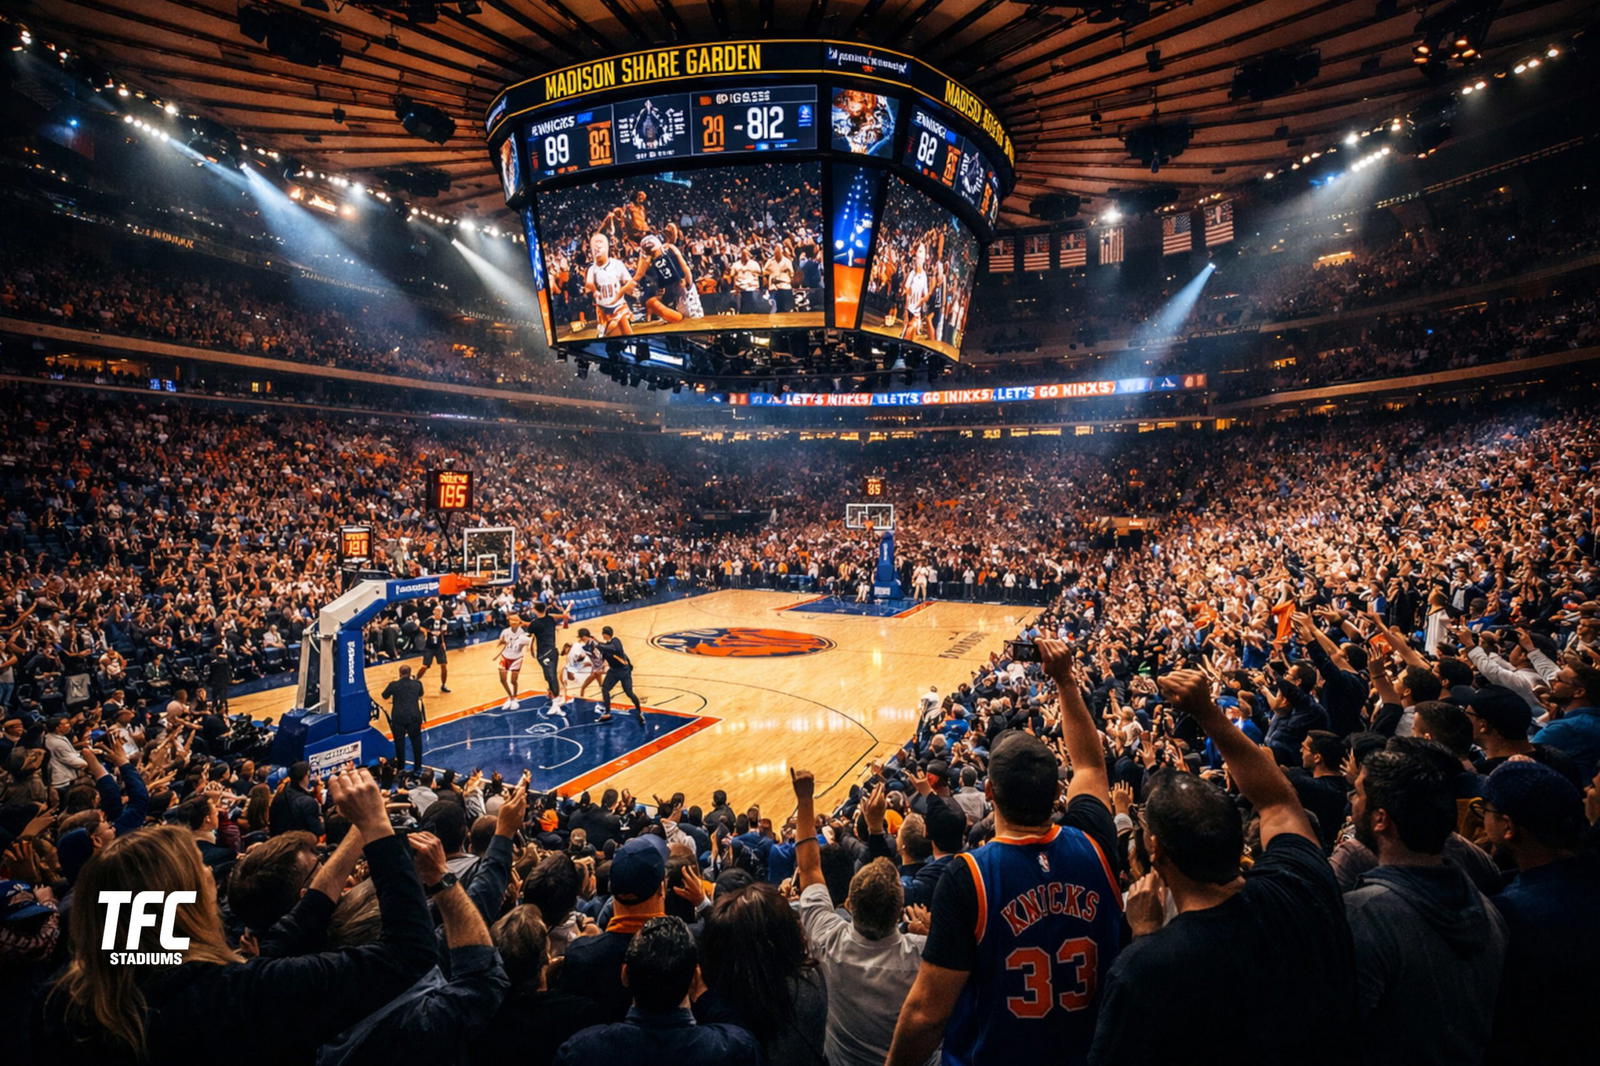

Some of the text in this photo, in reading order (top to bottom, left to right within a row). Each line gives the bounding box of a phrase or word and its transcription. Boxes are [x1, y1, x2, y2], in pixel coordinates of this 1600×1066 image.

[545, 44, 761, 101] MADISON SHARE GARDEN
[544, 133, 570, 167] 89
[1040, 385, 1059, 398] GO
[1000, 882, 1100, 937] KNICKS
[1005, 936, 1099, 1019] 33
